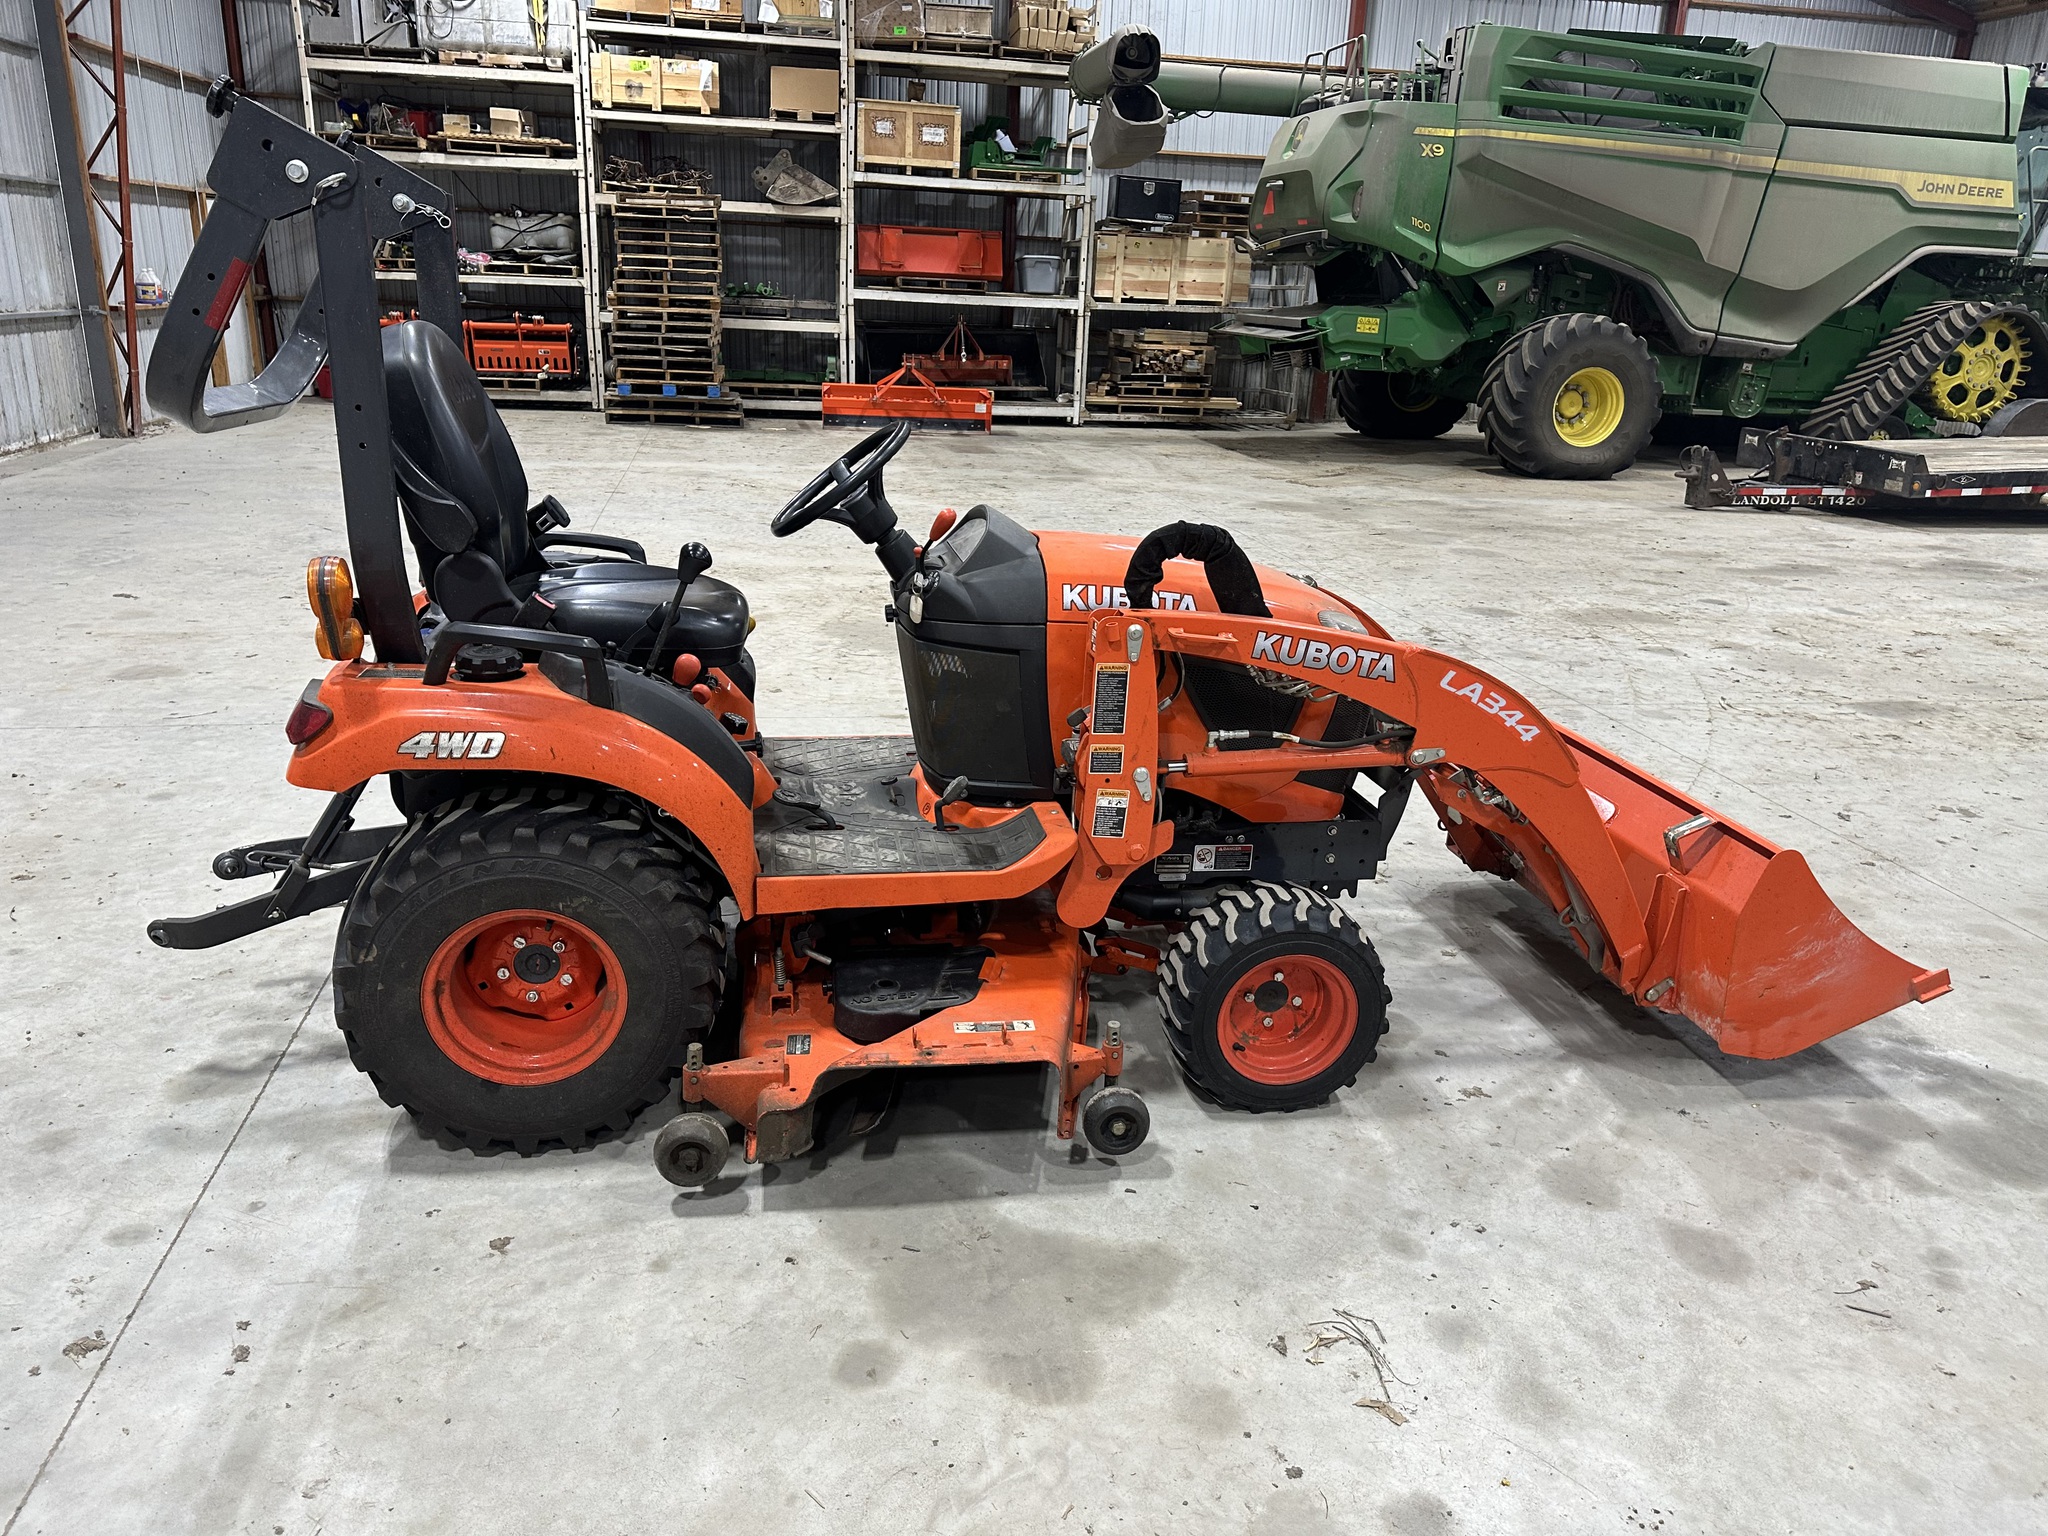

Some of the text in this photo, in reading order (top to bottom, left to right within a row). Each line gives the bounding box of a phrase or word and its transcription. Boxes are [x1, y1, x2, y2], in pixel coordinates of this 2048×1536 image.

[1420, 142, 1445, 158] X9
[1917, 180, 2004, 199] JOHN DEERE
[1411, 216, 1431, 232] 1100
[1731, 495, 1800, 506] LANDOLL
[1251, 630, 1396, 683] KUBOTA
[1439, 669, 1541, 743] LA344
[397, 731, 507, 760] 4WD
[850, 990, 917, 1005] NO STEP
